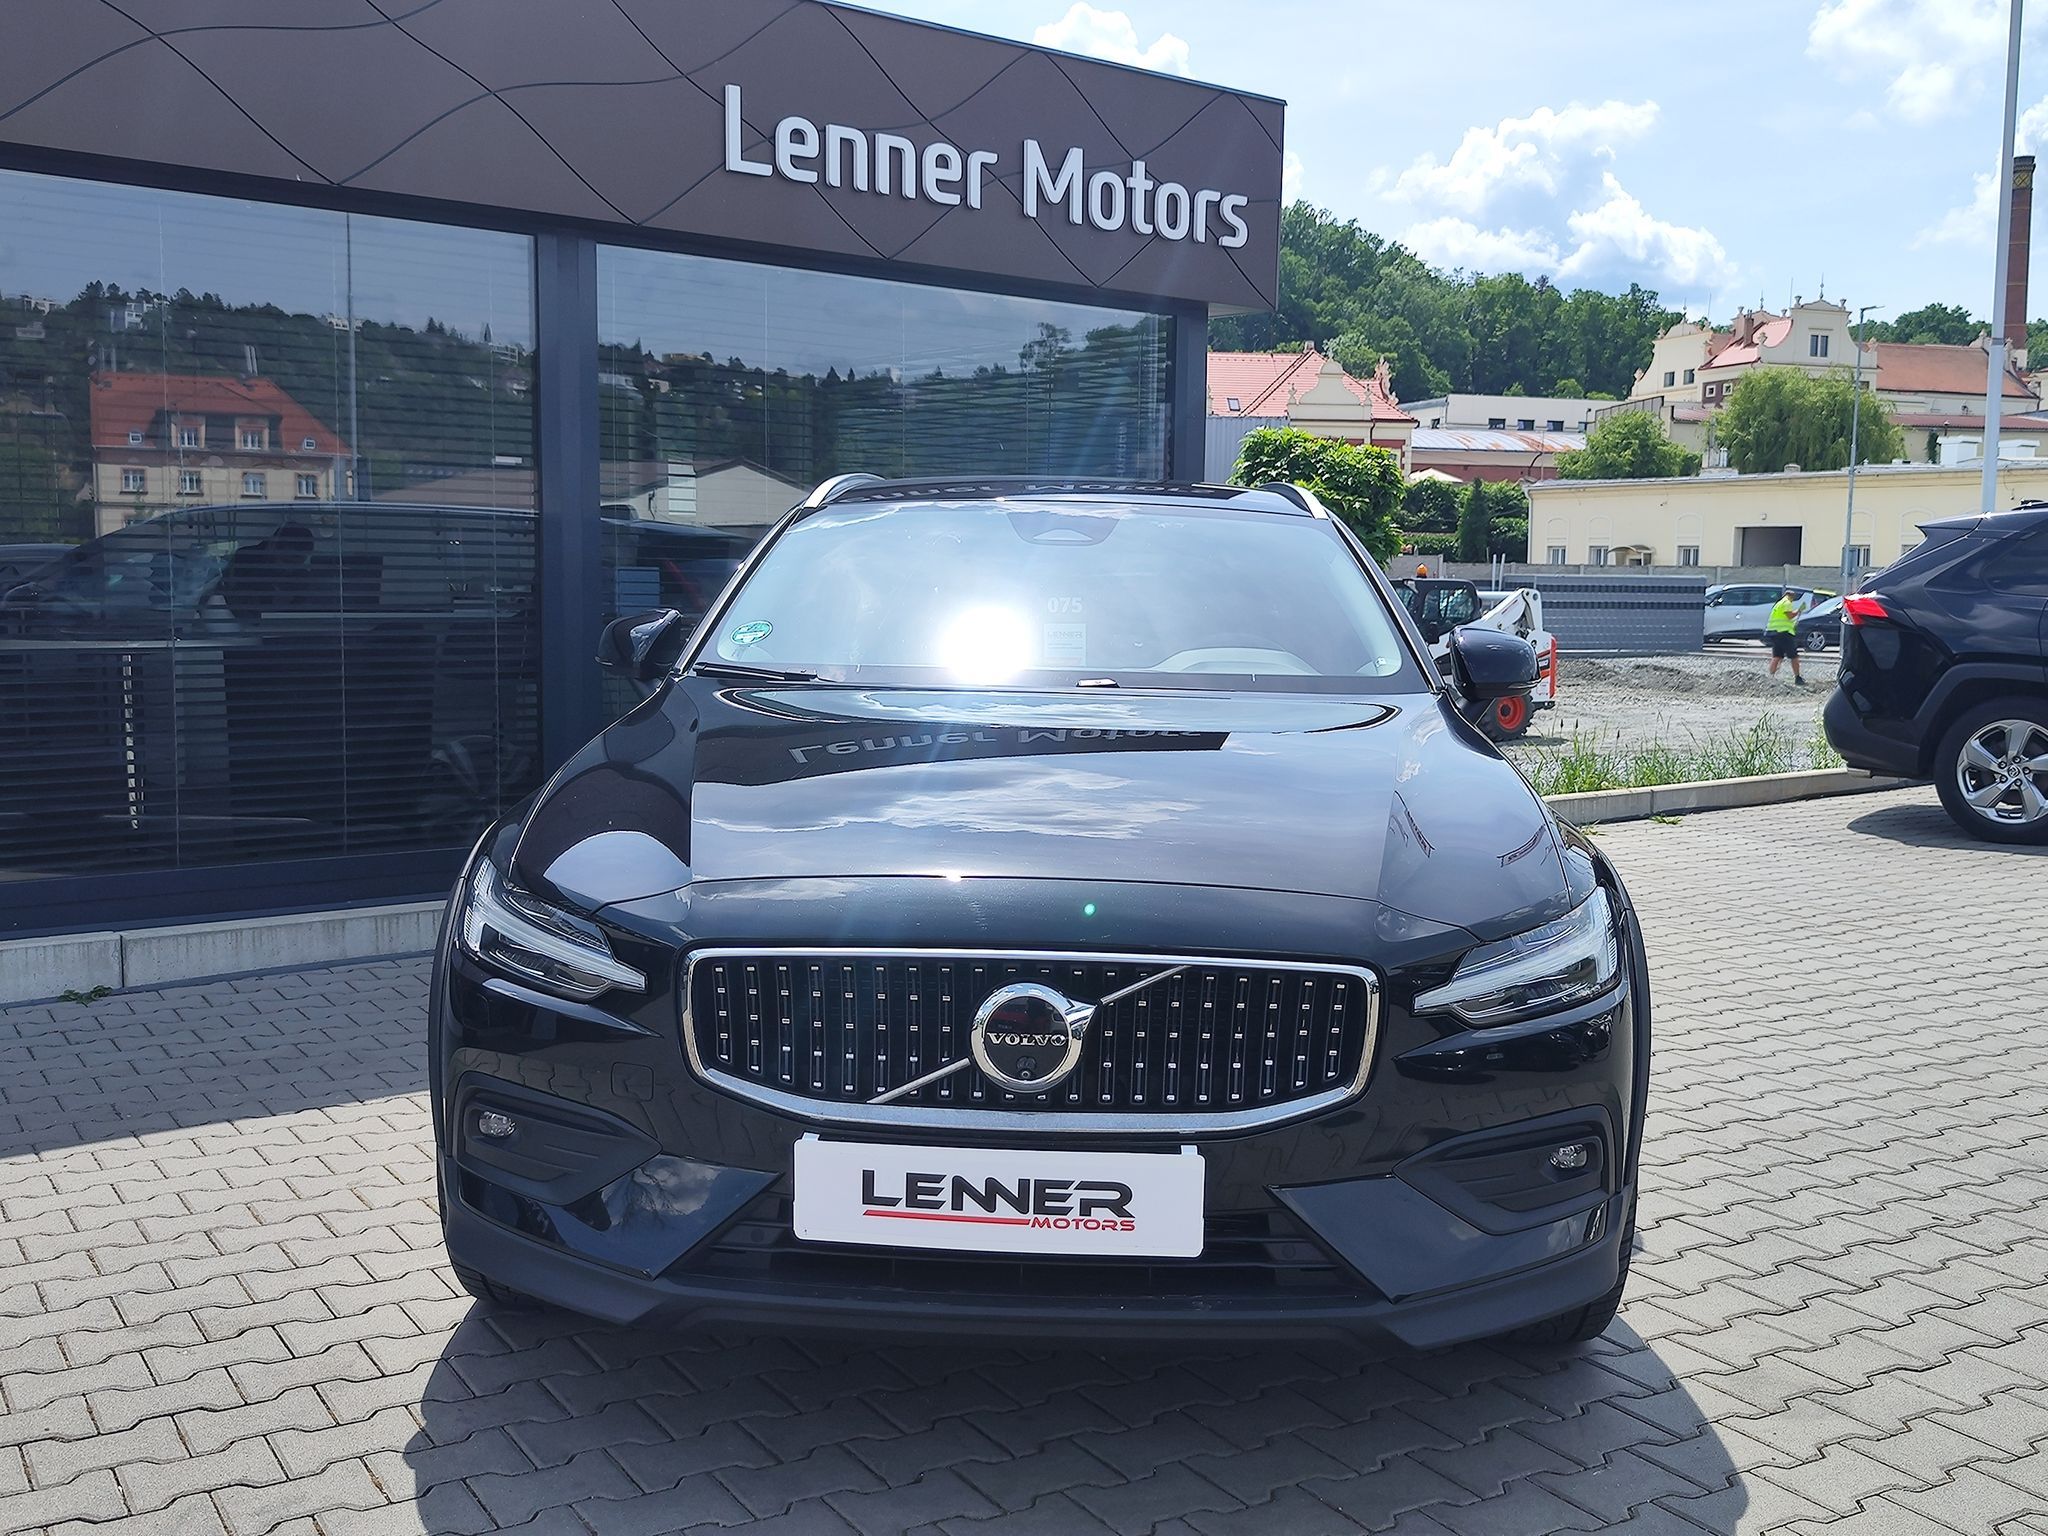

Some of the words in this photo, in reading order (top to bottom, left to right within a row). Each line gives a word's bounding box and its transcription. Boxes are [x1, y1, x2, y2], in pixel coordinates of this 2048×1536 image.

[724, 83, 998, 210] Lenner
[1022, 138, 1249, 249] Motors
[1047, 596, 1083, 613] 075
[986, 1032, 1067, 1047] VOLVO
[862, 1169, 1136, 1217] LENNER
[1030, 1216, 1136, 1232] MOTORS
